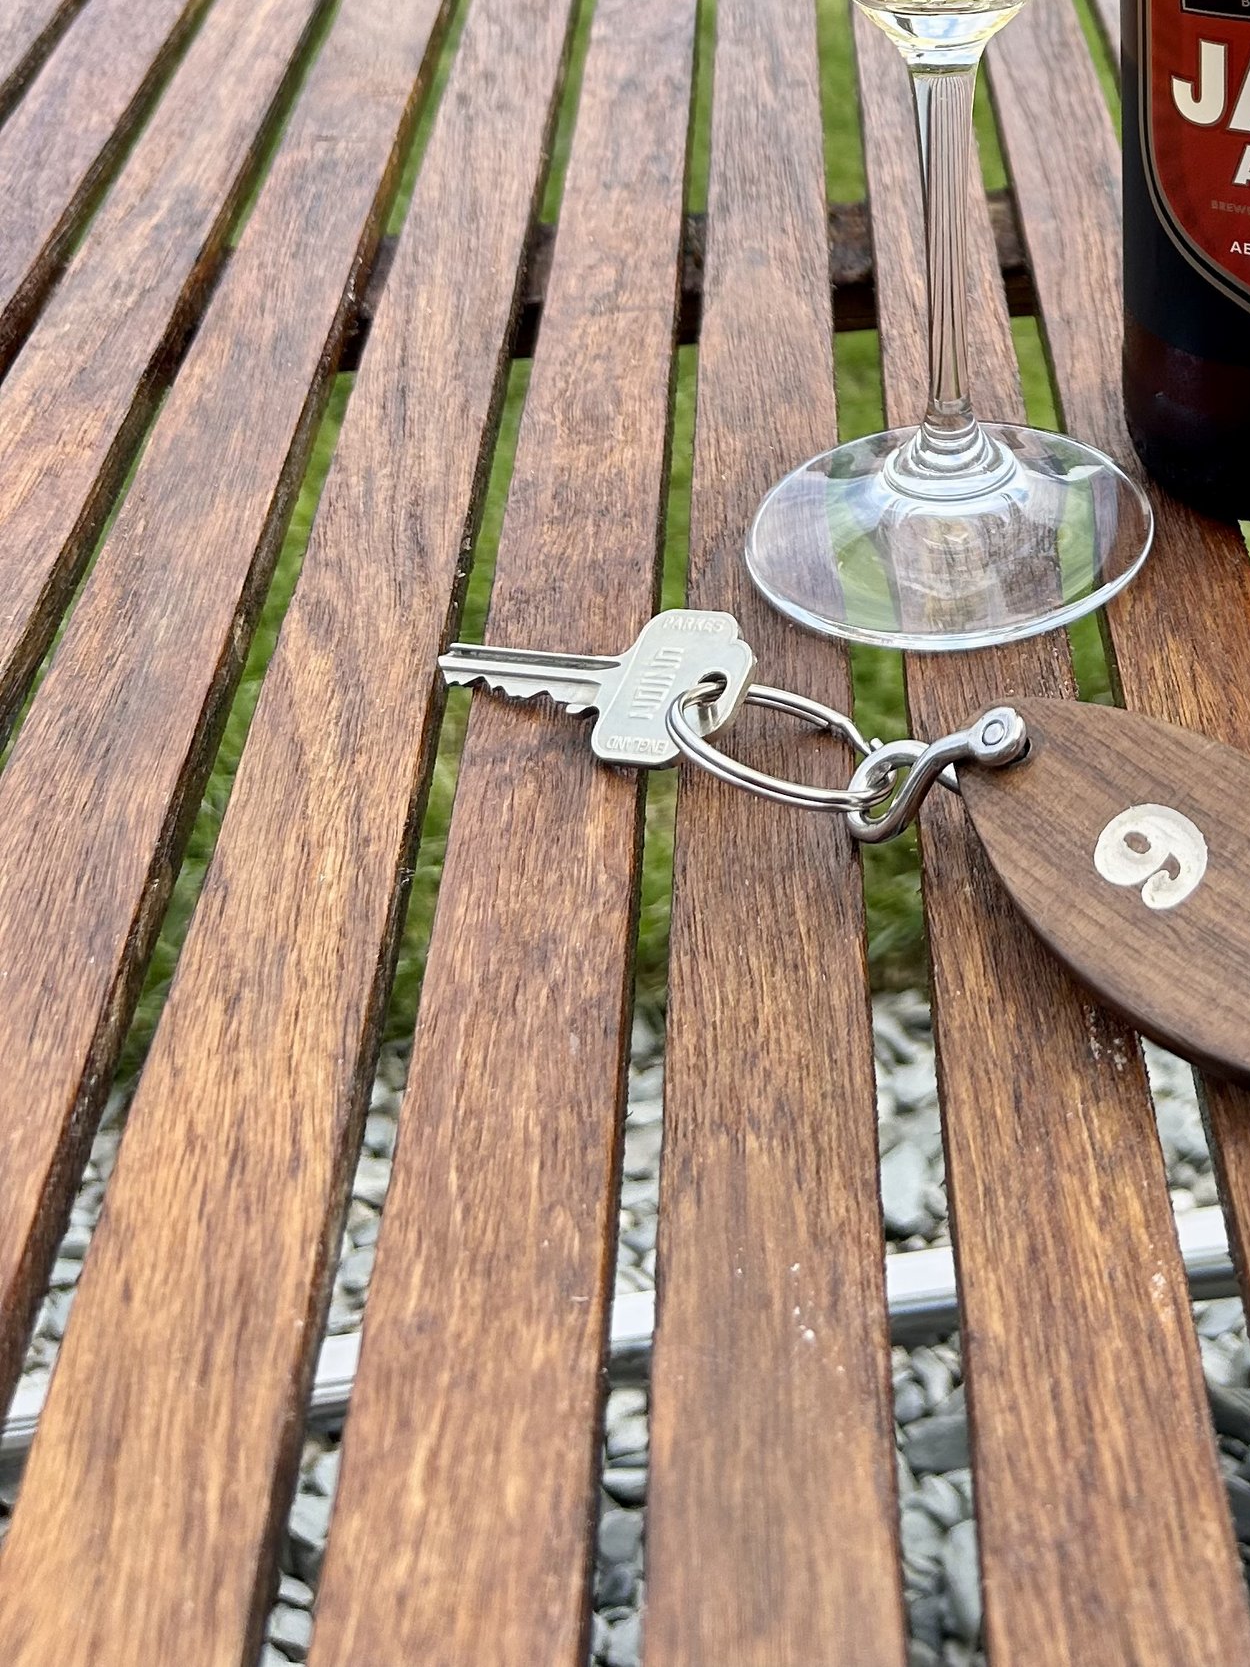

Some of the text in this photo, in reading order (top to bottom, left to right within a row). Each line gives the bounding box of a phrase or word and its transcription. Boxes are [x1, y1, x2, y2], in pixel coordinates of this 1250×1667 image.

[662, 616, 726, 633] PARKES
[629, 647, 685, 720] UNION
[606, 736, 669, 756] ENGLAND
[1093, 802, 1209, 910] 9
